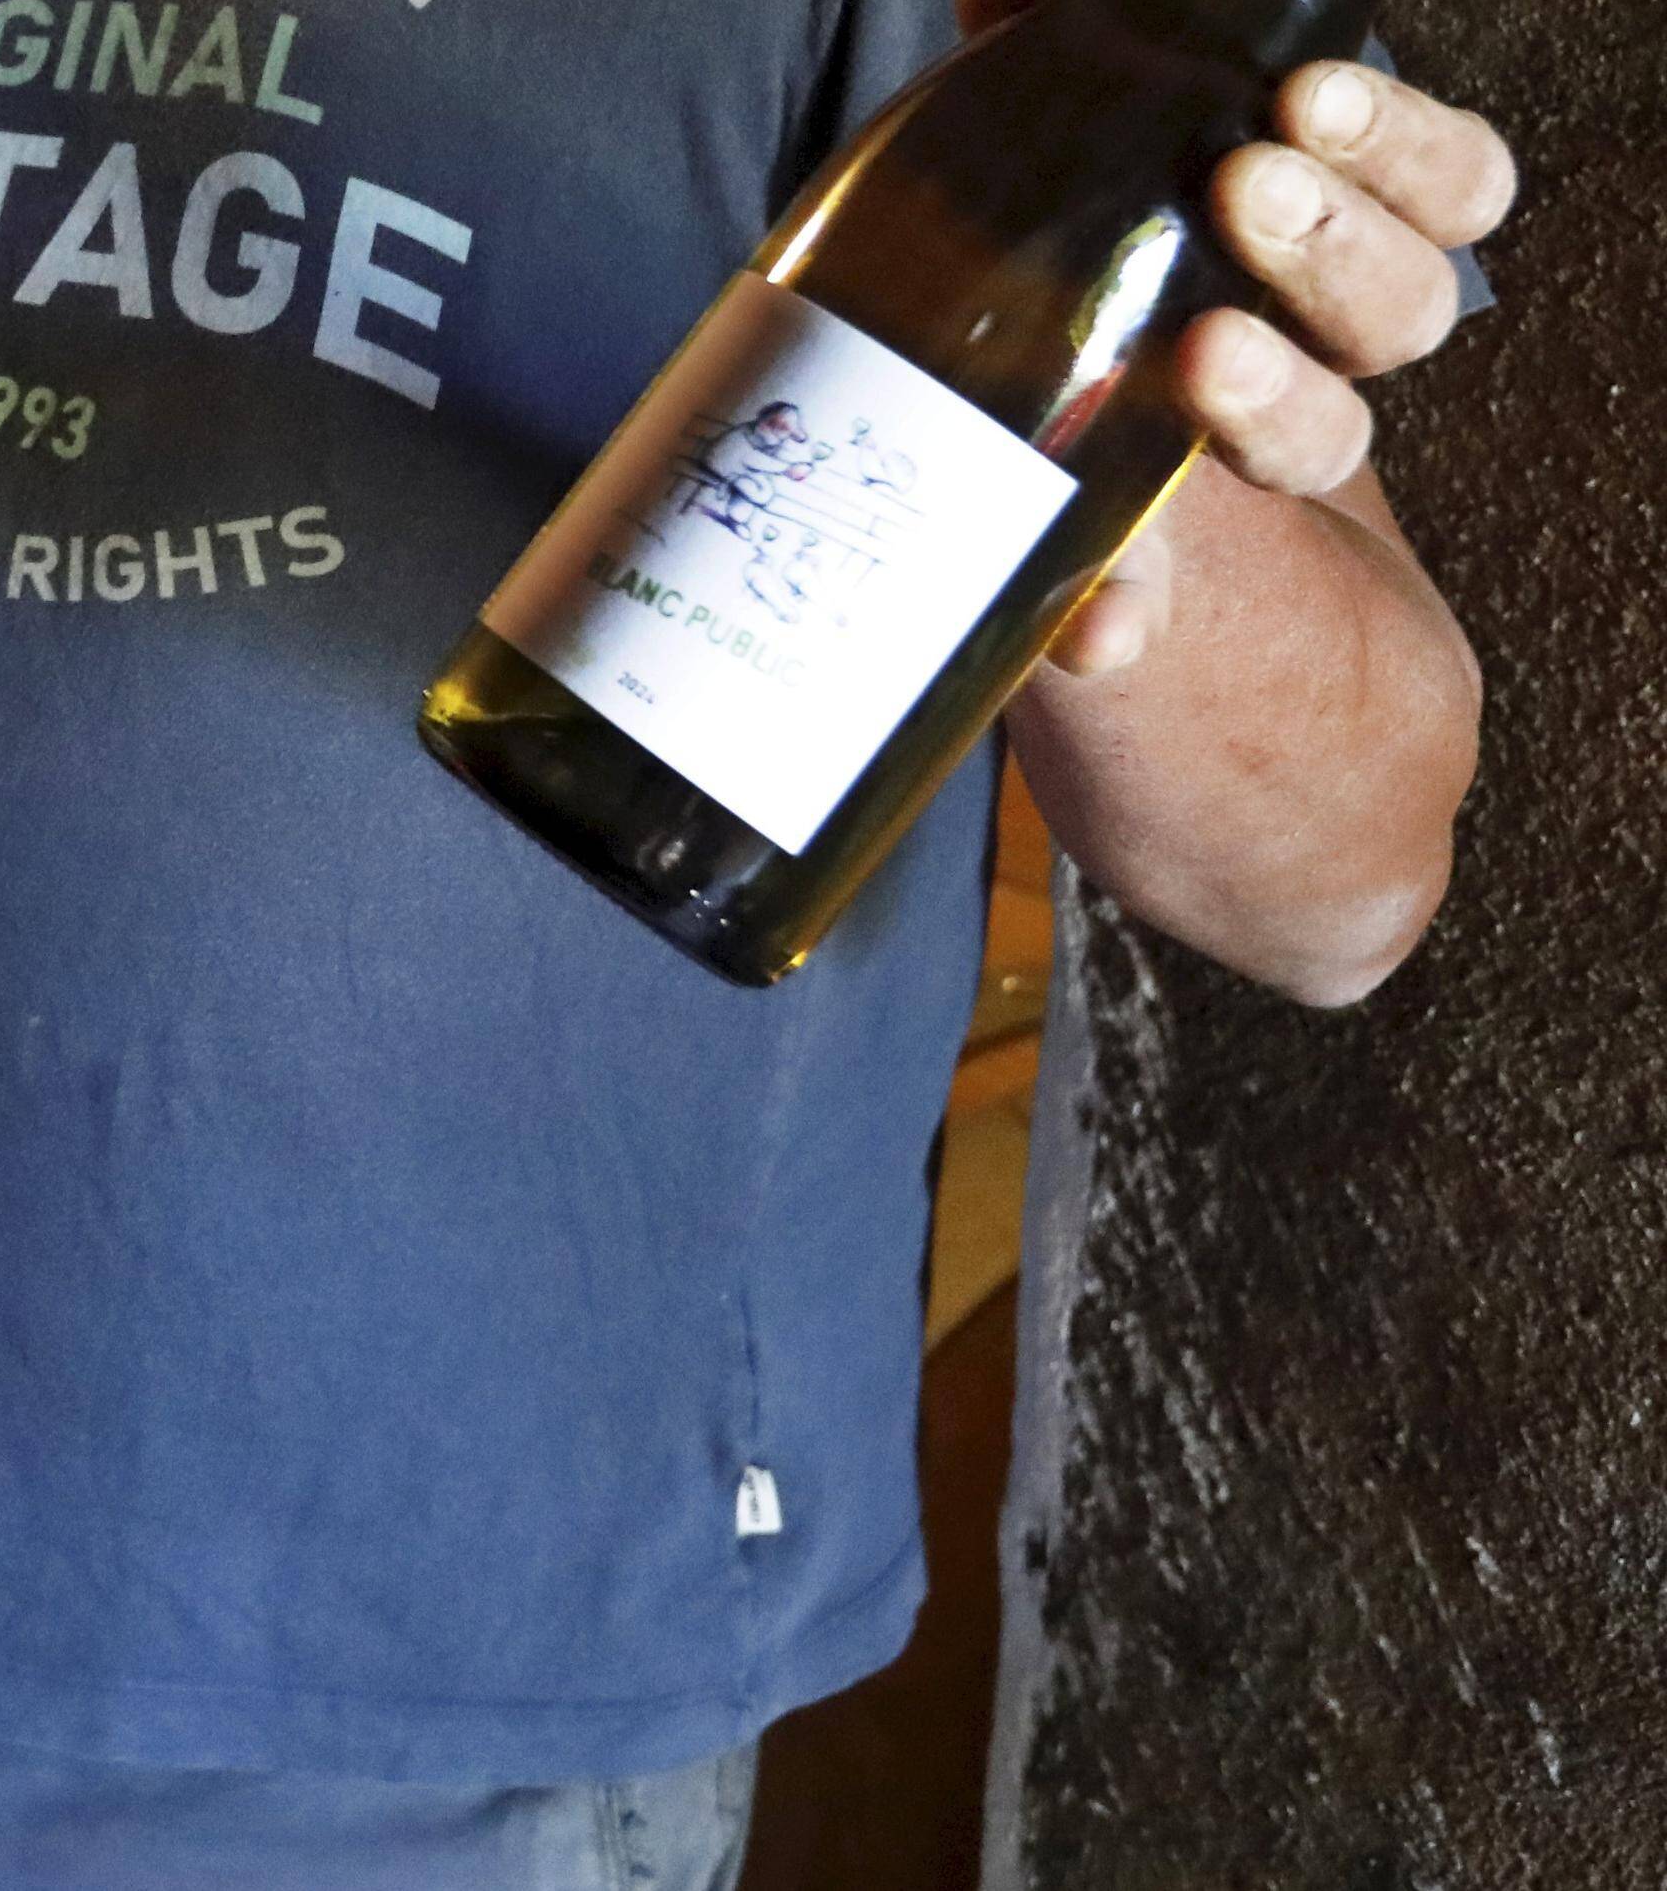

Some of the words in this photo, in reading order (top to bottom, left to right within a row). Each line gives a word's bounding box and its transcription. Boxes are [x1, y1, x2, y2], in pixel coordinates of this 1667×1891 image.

[7, 506, 346, 603] RIGHTS
[587, 551, 684, 618] BLANC
[684, 604, 806, 688] PUBLIC
